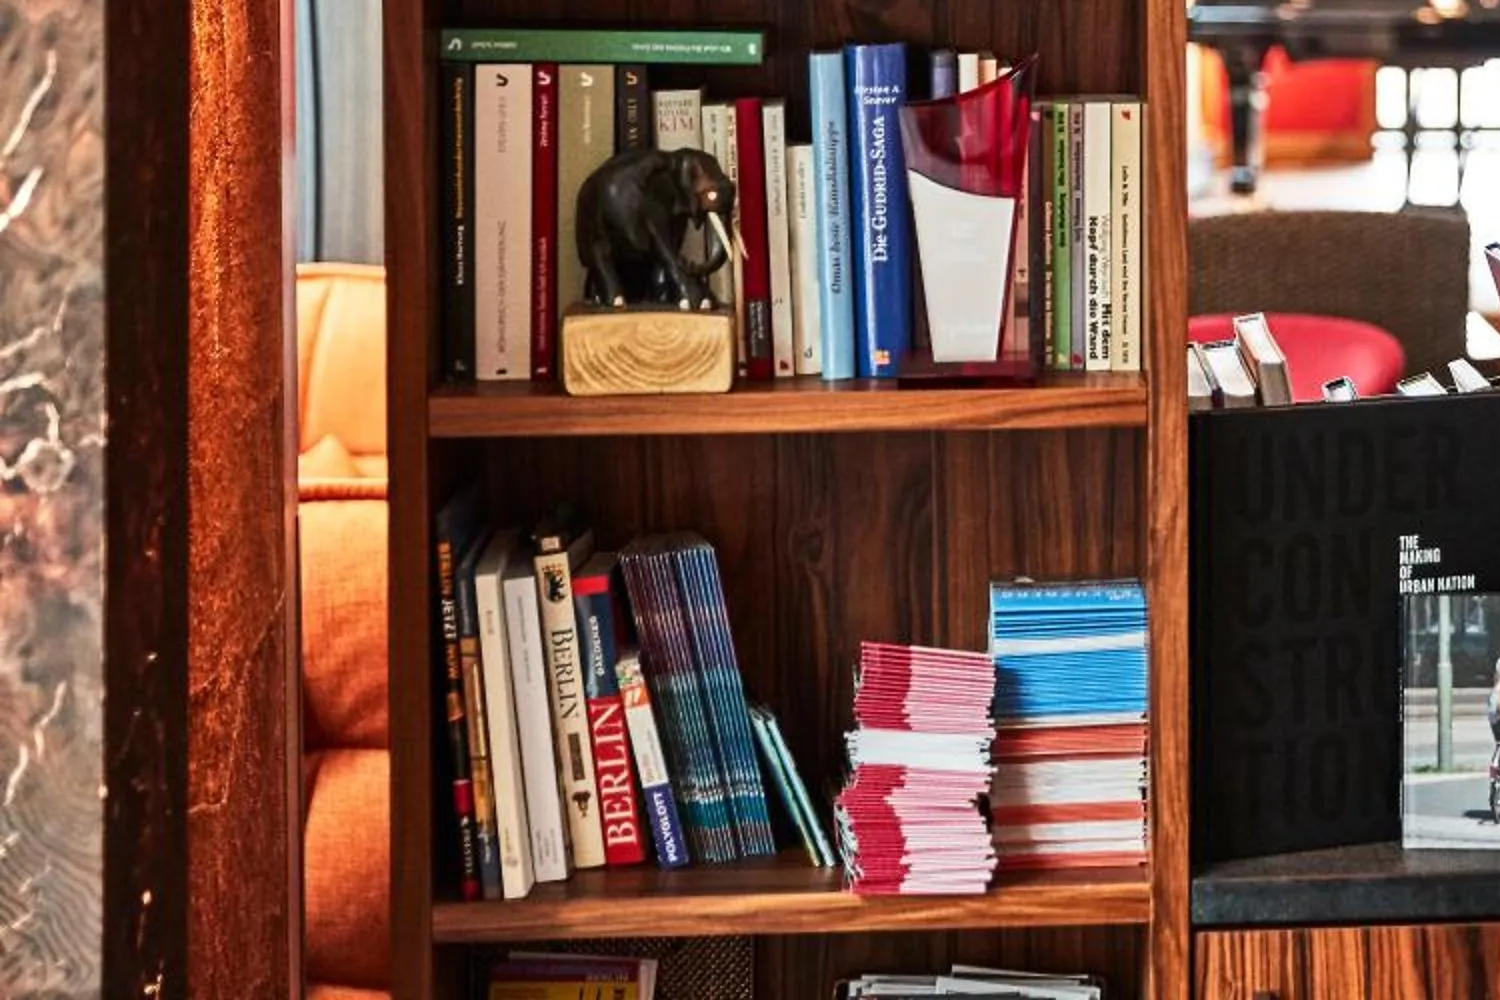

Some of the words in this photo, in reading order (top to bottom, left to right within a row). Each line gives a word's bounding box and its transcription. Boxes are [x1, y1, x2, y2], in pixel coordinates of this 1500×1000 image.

[871, 116, 887, 229] GUDRID-SAGA
[872, 235, 887, 262] Die
[1087, 254, 1098, 295] durch
[1087, 299, 1098, 318] die
[1102, 303, 1111, 325] Mit
[1087, 322, 1098, 360] Wand
[1102, 329, 1111, 359] dem
[1400, 535, 1419, 550] THE
[1400, 565, 1413, 579] OF
[1400, 578, 1435, 594] URBAN
[1437, 574, 1475, 591] NATION
[549, 629, 580, 720] BERLIN
[589, 699, 638, 848] BERLIN
[653, 790, 679, 862] POLYGLOTT
